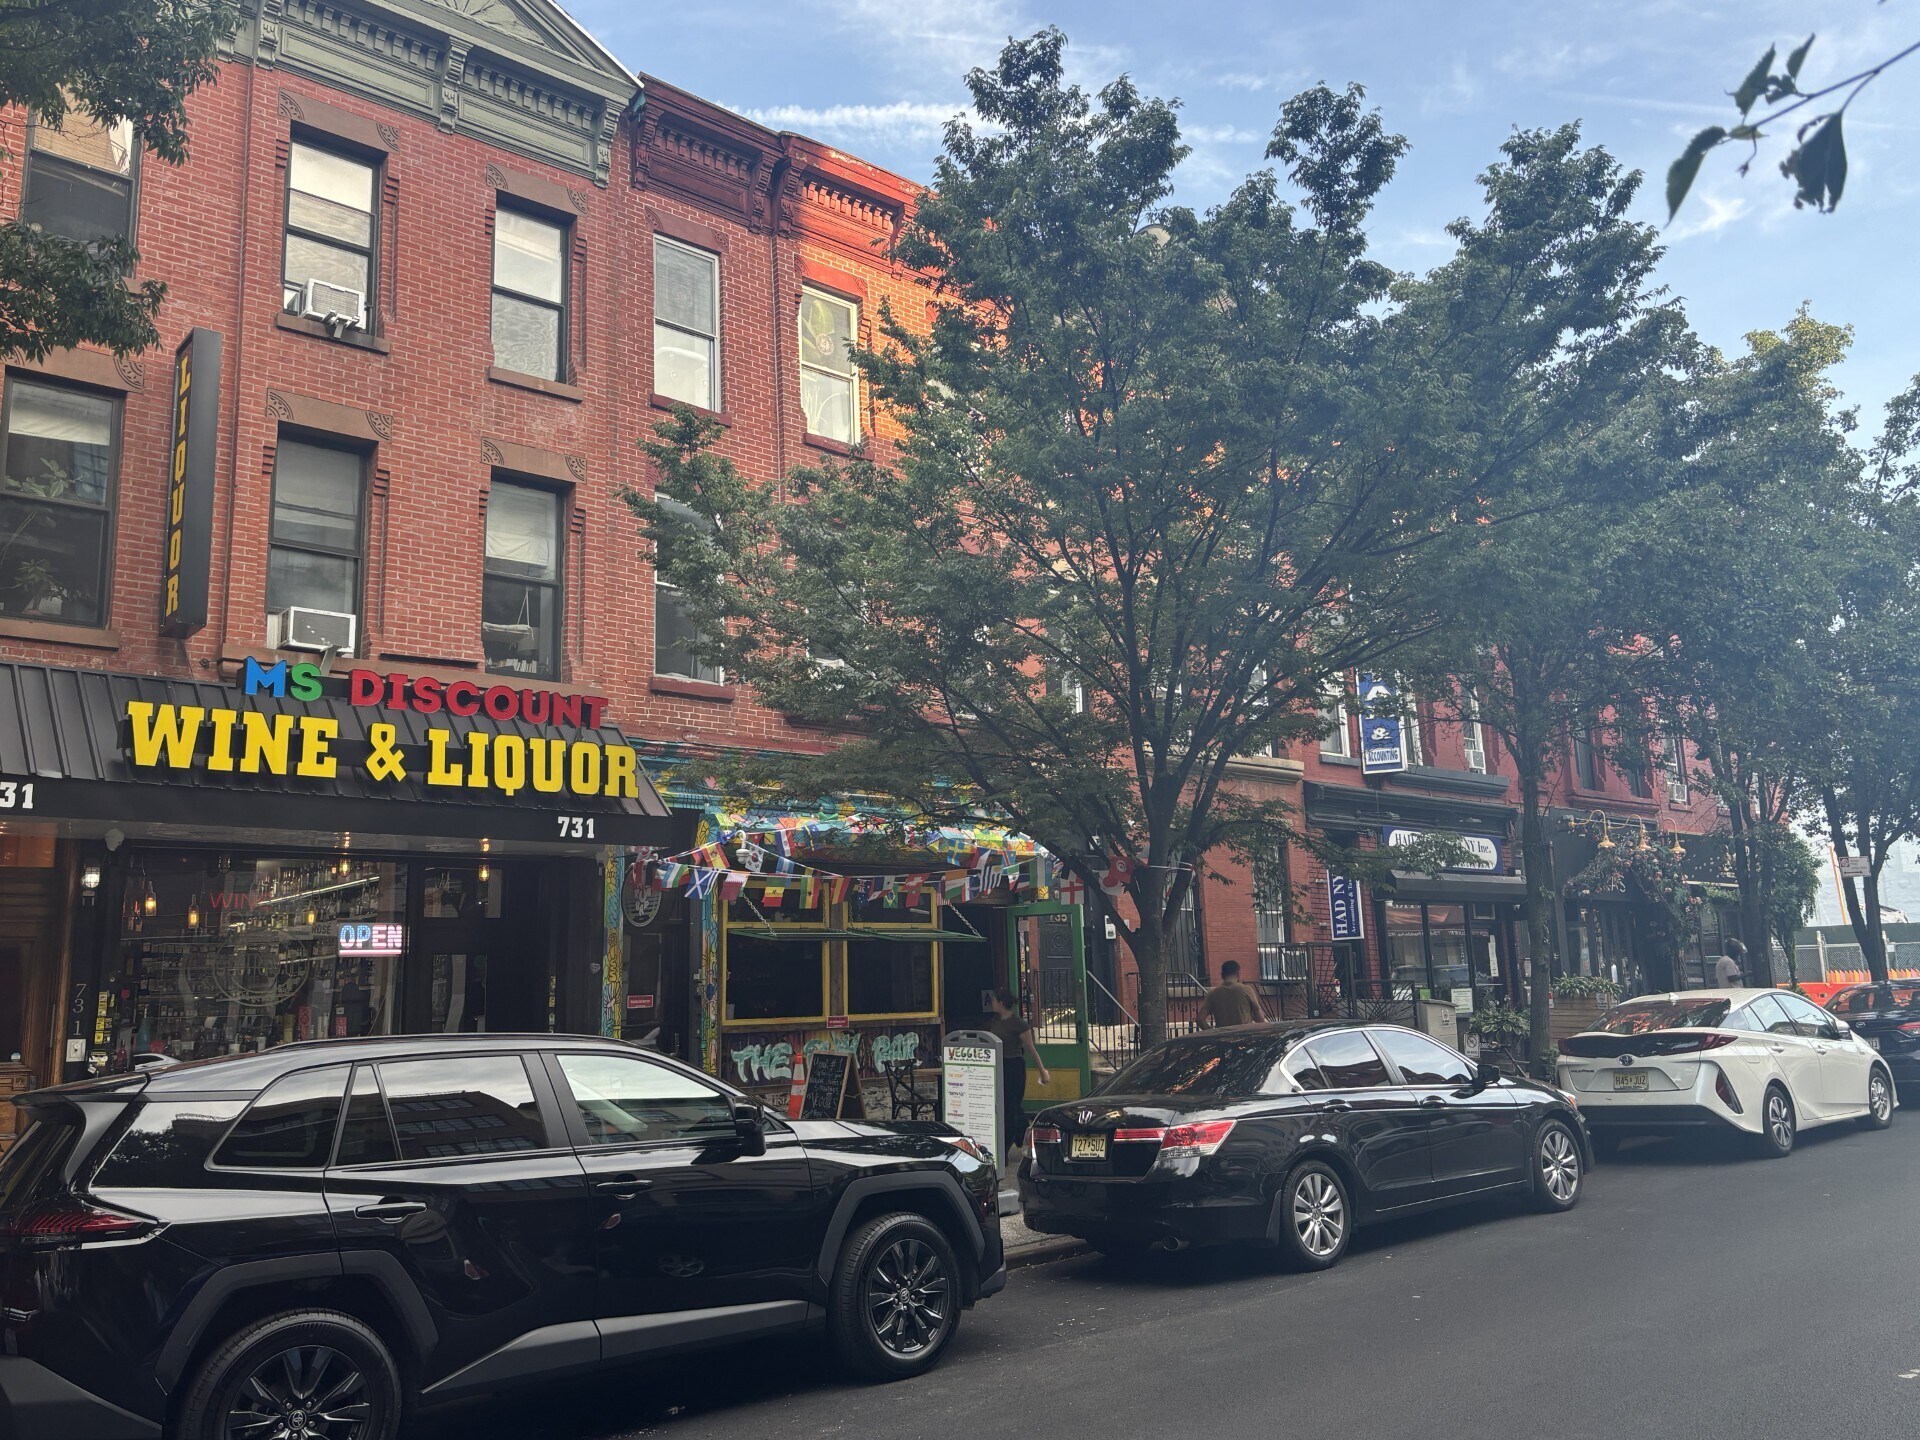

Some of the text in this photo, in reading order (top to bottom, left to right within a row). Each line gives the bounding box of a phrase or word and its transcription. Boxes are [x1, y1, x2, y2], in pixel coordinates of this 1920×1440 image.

[164, 355, 191, 617] LIQUOR
[245, 656, 609, 729] MS DISCOUNT
[127, 700, 640, 798] WINE & LIQUOR
[1367, 749, 1398, 763] ACCOUNTING
[557, 816, 595, 839] 731
[1335, 899, 1348, 935] HAD
[339, 925, 402, 949] OPEN
[72, 983, 87, 1036] 731
[730, 1041, 793, 1083] THE
[948, 1048, 991, 1060] VEGGIES
[1074, 1138, 1104, 1152] T27 SUZ
